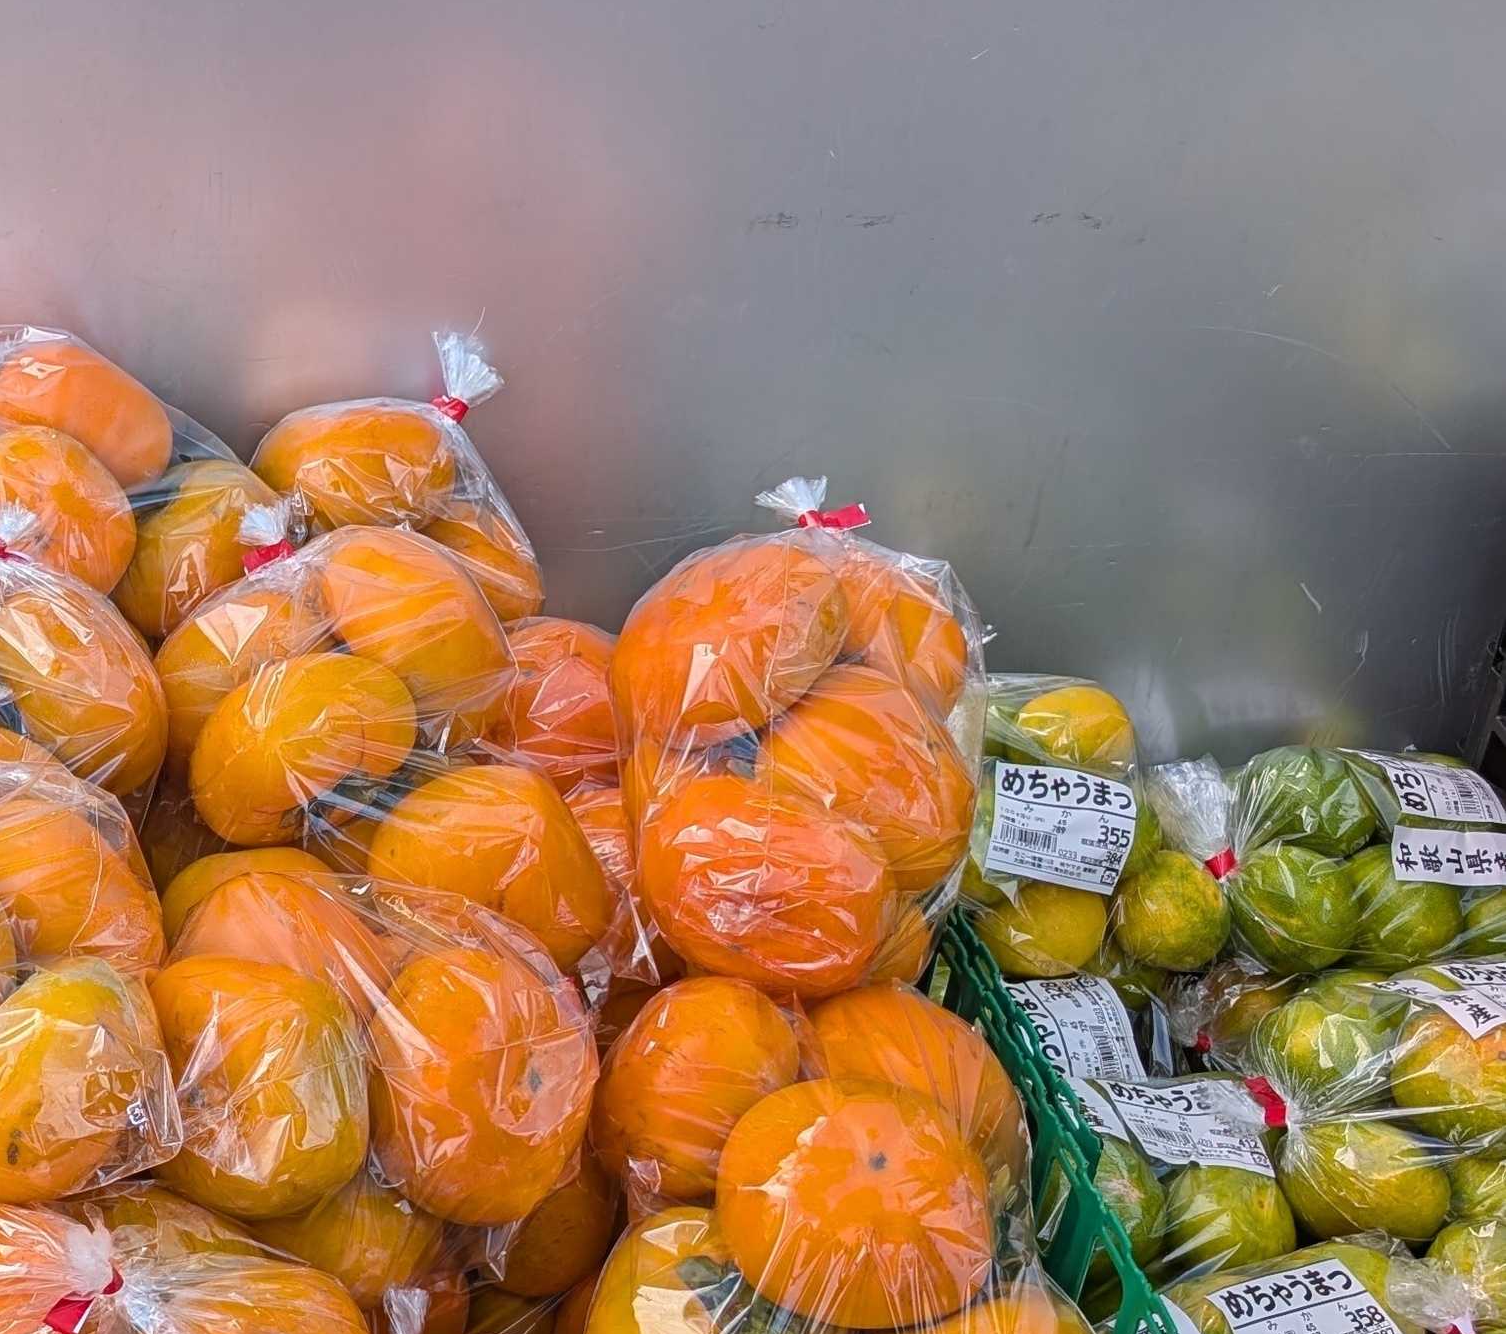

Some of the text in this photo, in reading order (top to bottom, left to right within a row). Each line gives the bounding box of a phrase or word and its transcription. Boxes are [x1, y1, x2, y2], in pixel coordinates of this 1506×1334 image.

[1001, 767, 1132, 810] めちゃうまっ
[1097, 825, 1131, 848] 355
[1218, 1269, 1352, 1320] めちゃうまっ
[1344, 1304, 1386, 1333] 358
